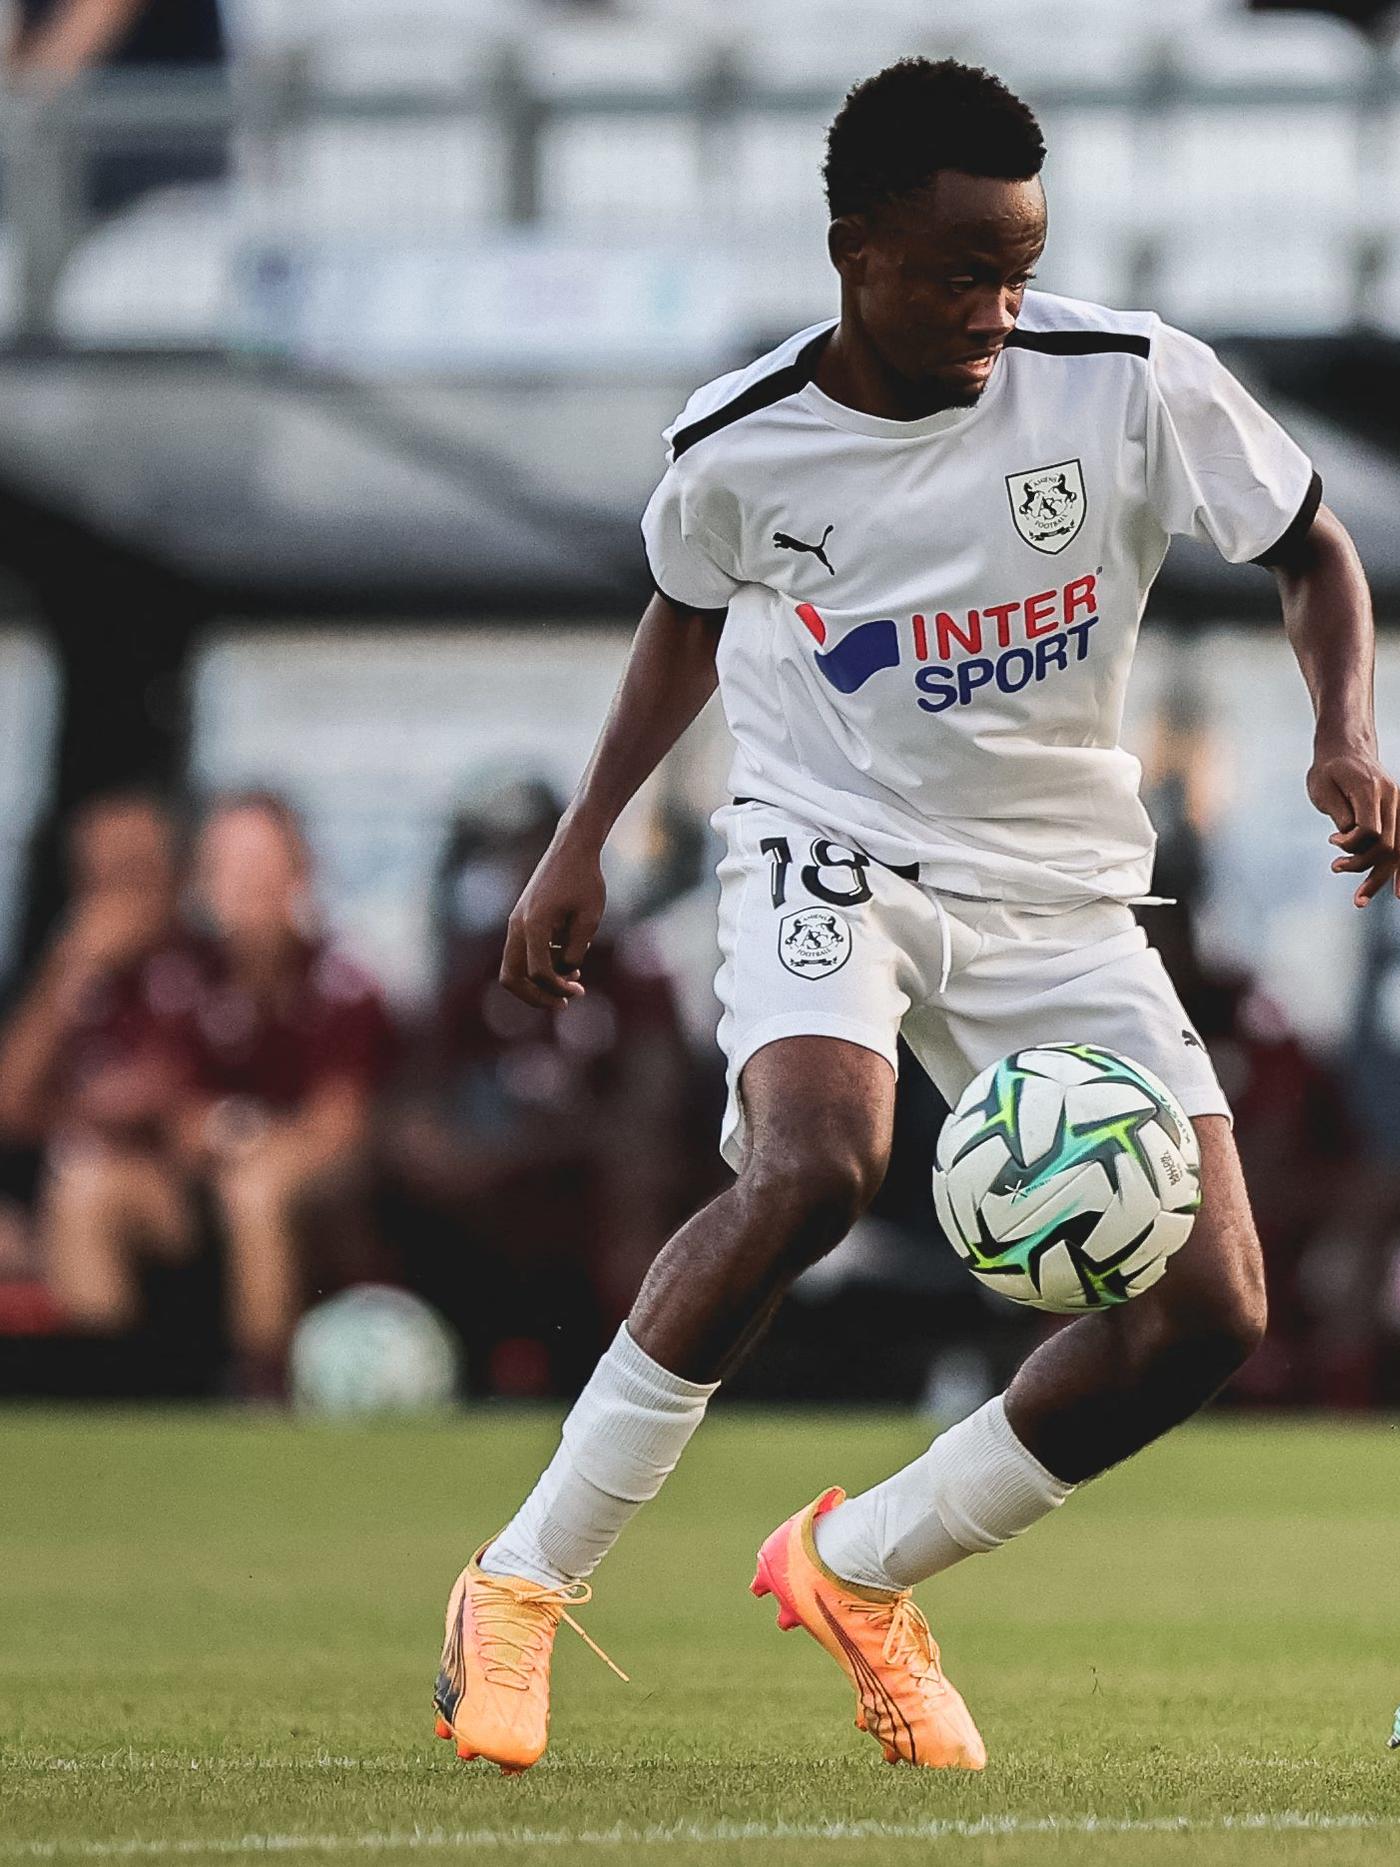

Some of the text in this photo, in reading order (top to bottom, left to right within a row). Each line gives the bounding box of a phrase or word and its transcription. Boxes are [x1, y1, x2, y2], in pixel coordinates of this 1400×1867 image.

[912, 574, 1097, 662] INTER
[914, 615, 1099, 713] SPORT
[760, 836, 873, 910] 18
